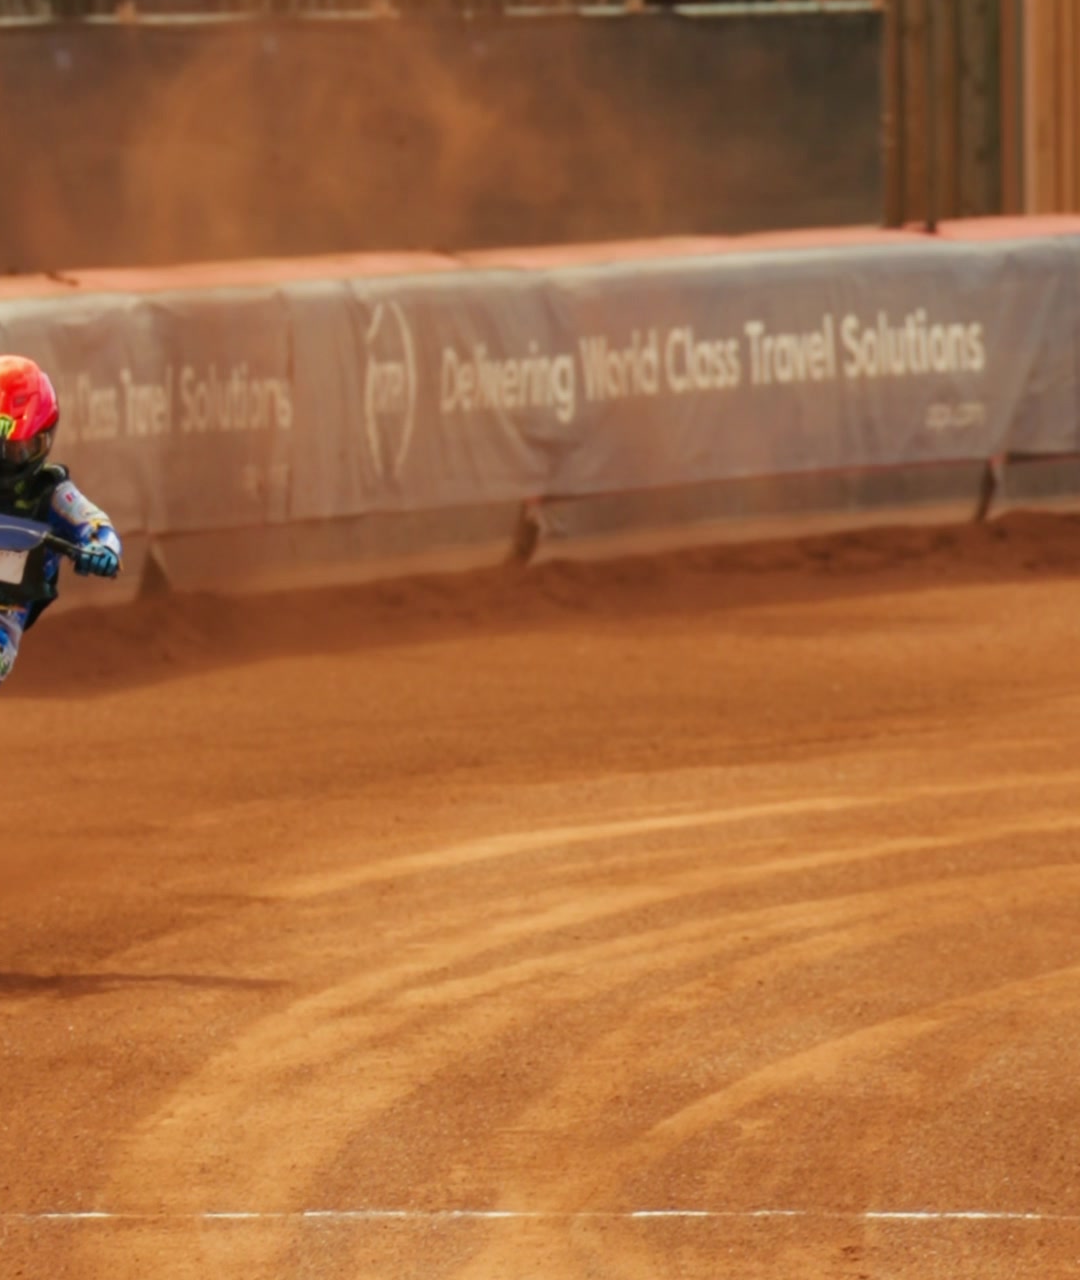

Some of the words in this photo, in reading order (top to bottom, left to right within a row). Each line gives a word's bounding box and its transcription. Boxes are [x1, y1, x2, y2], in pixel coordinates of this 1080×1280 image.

[179, 359, 293, 434] Solutions
[439, 342, 576, 422] Delivering
[577, 326, 659, 402] World
[665, 324, 740, 393] Class
[744, 318, 836, 386] Travel
[839, 306, 986, 380] Solutions
